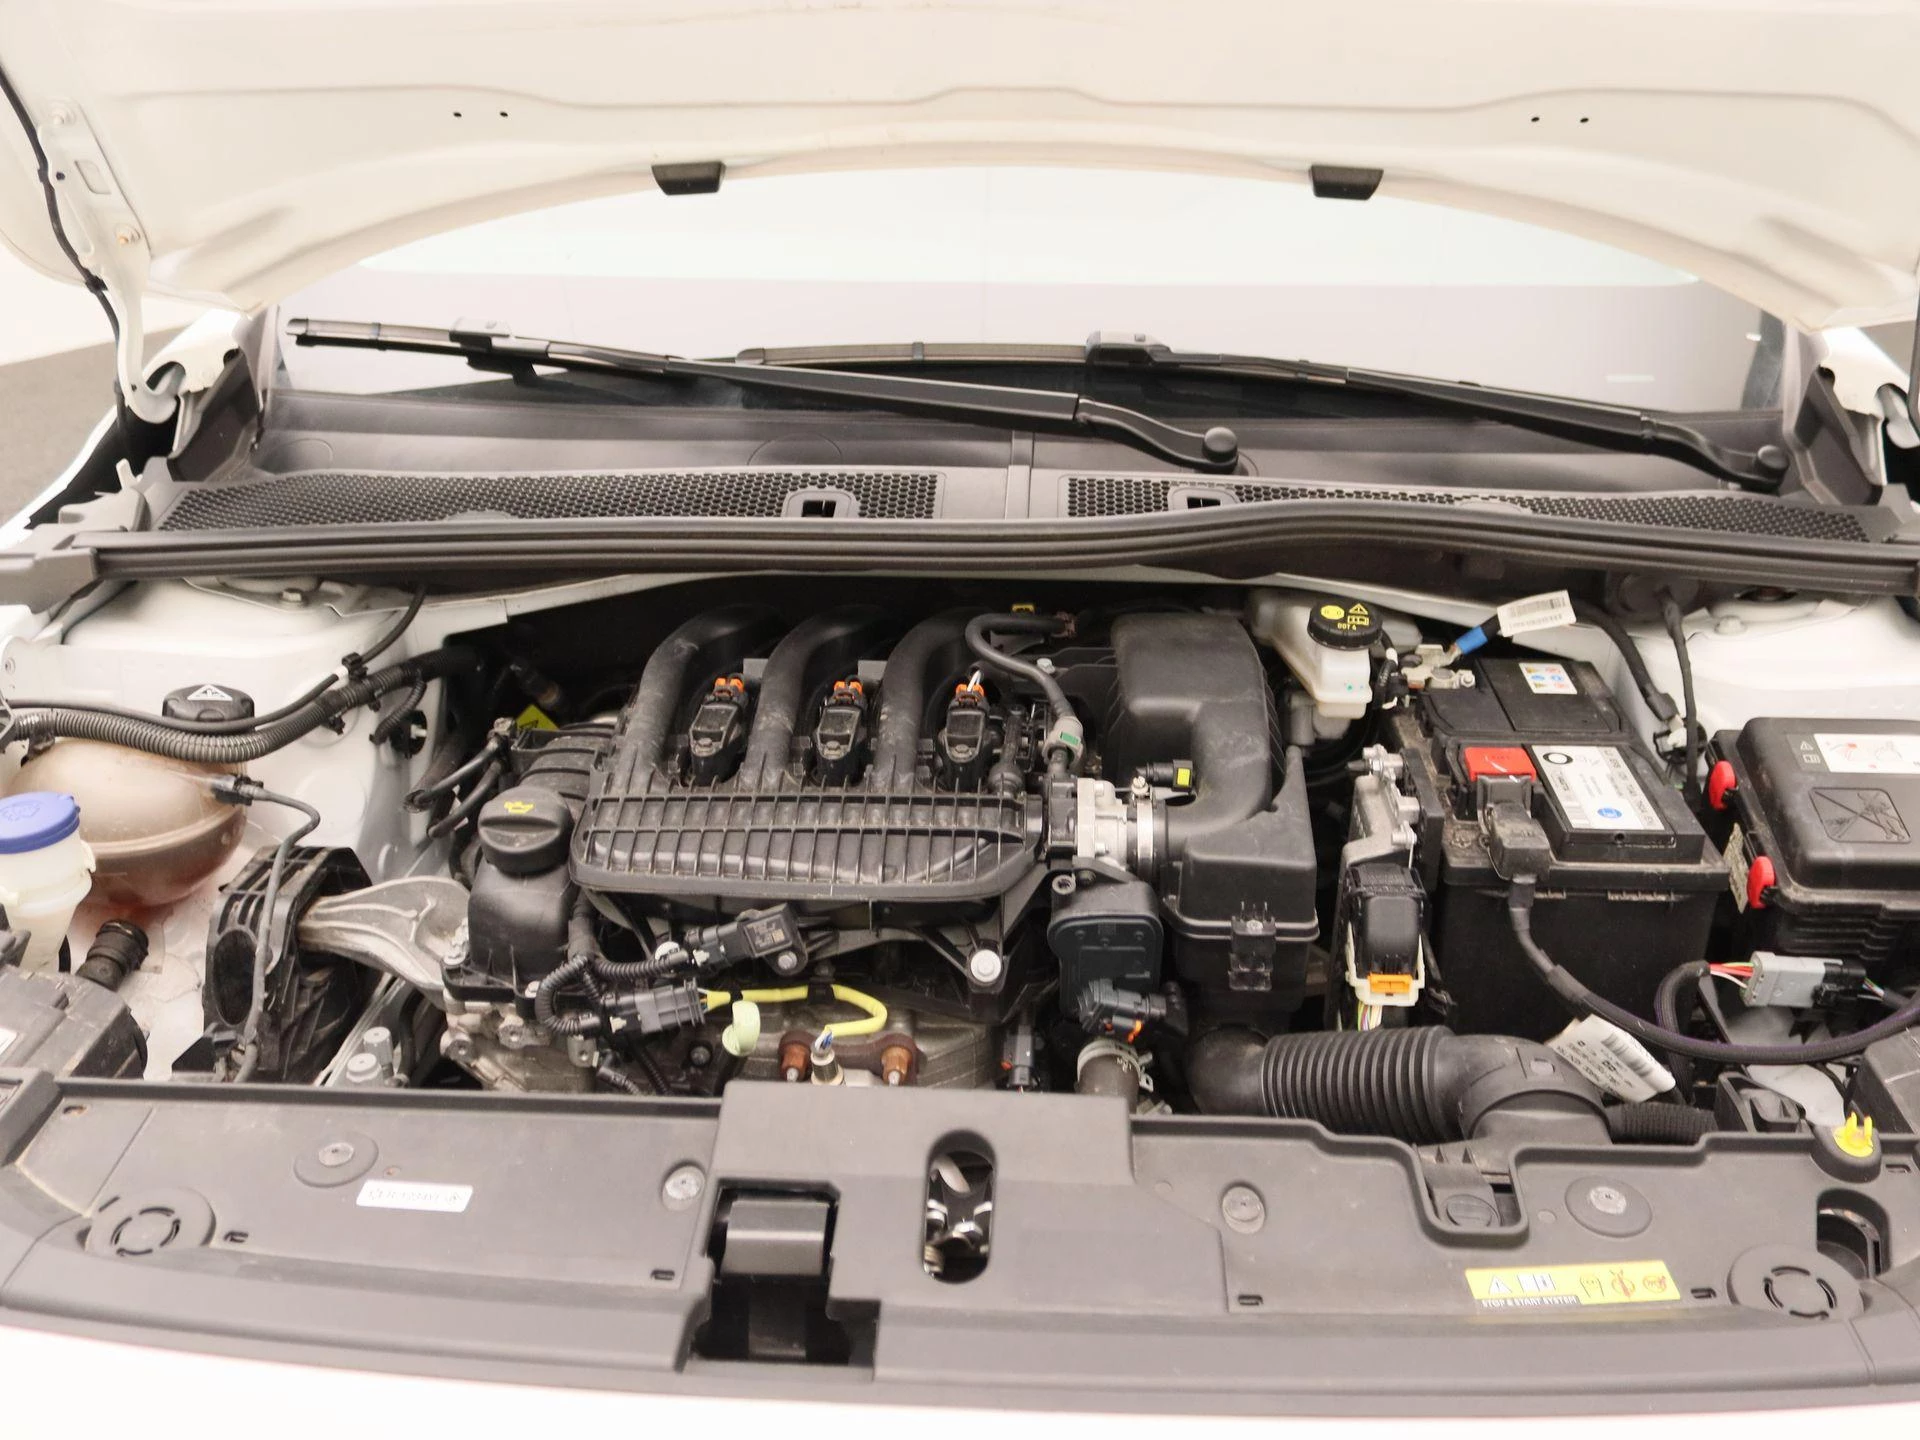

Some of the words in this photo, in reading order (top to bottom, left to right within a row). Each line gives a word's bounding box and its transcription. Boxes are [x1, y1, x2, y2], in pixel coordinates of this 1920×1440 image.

[1337, 622, 1350, 630] DOT
[1481, 1299, 1505, 1308] STOP
[1513, 1297, 1541, 1306] START
[1542, 1295, 1577, 1305] SYSTEM
